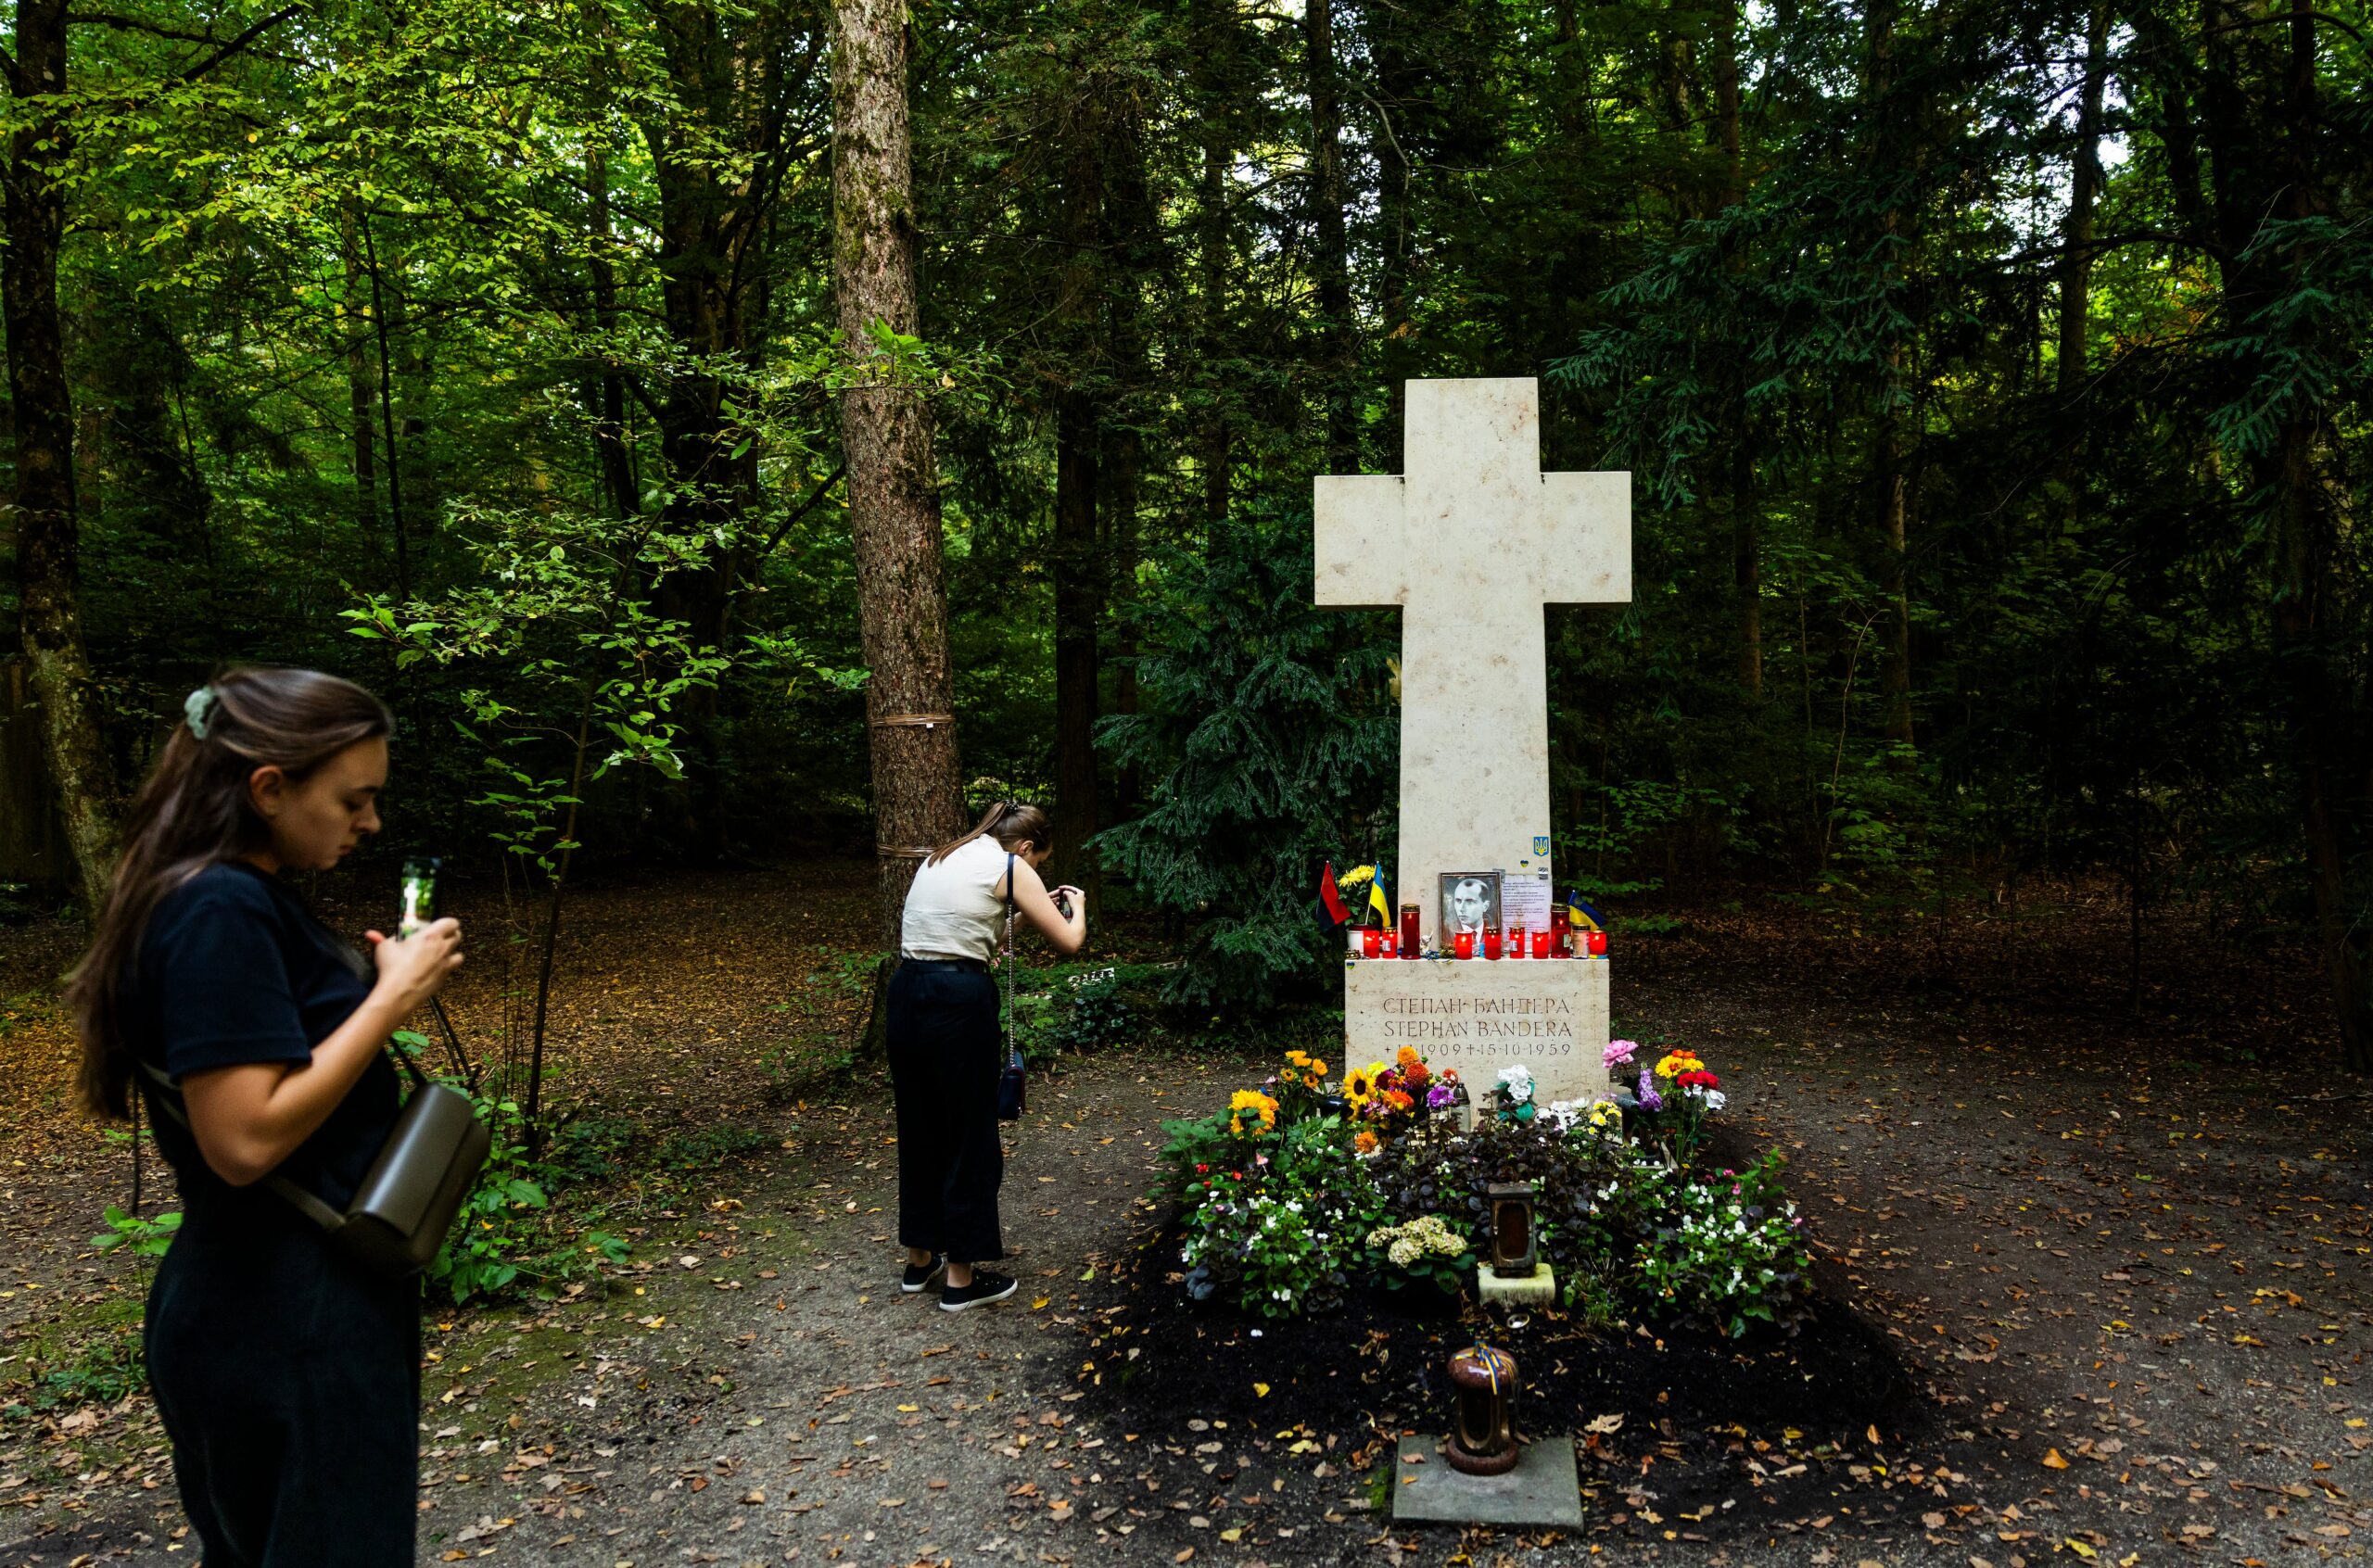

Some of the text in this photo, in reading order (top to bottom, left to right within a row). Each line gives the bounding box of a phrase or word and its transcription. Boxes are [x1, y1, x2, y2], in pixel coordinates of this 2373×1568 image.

[1383, 997, 1570, 1015] СТЕПАН БАНДЕРА
[1384, 1020, 1572, 1037] STEPHAN BANDERA
